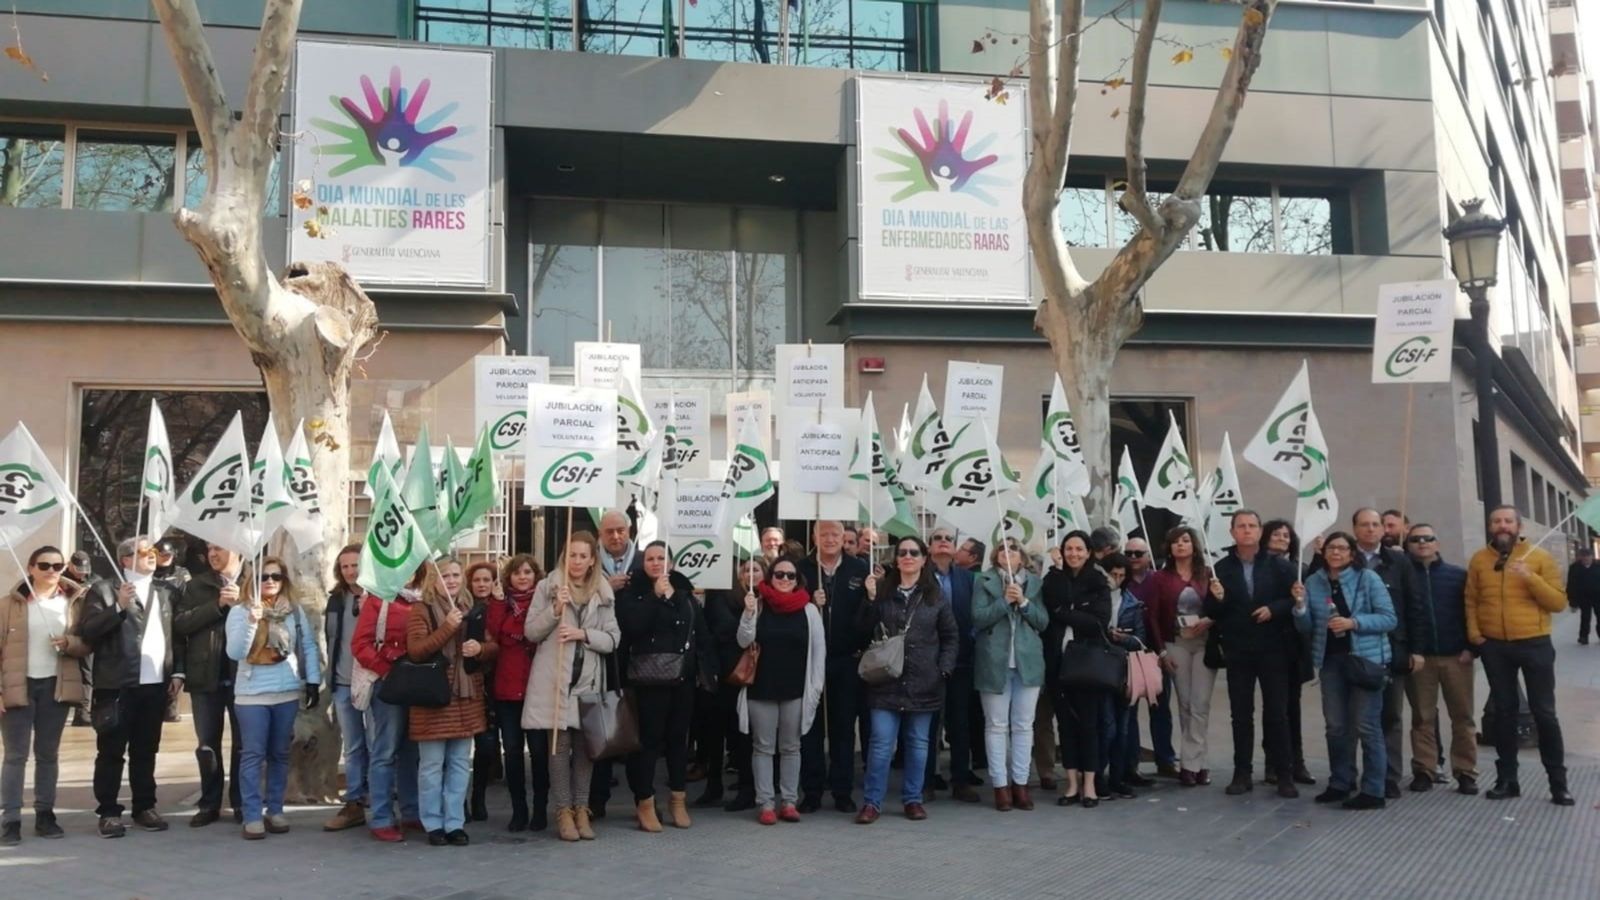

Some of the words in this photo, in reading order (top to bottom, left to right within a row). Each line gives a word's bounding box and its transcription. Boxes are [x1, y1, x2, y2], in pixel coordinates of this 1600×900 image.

[318, 184, 344, 204] DIA
[350, 186, 421, 206] MUNDIAL
[426, 193, 441, 206] DE
[444, 194, 466, 207] LES
[316, 208, 408, 228] MALALTIES
[412, 210, 466, 230] RARES
[882, 209, 905, 226] DIA
[909, 210, 970, 229] MUNDIAL
[974, 218, 986, 230] DE
[990, 218, 1008, 230] LAS
[882, 230, 972, 250] ENFERMEDADES
[974, 232, 1010, 250] RARAS
[962, 392, 988, 400] PARCIAL
[553, 418, 595, 428] PARCIAL
